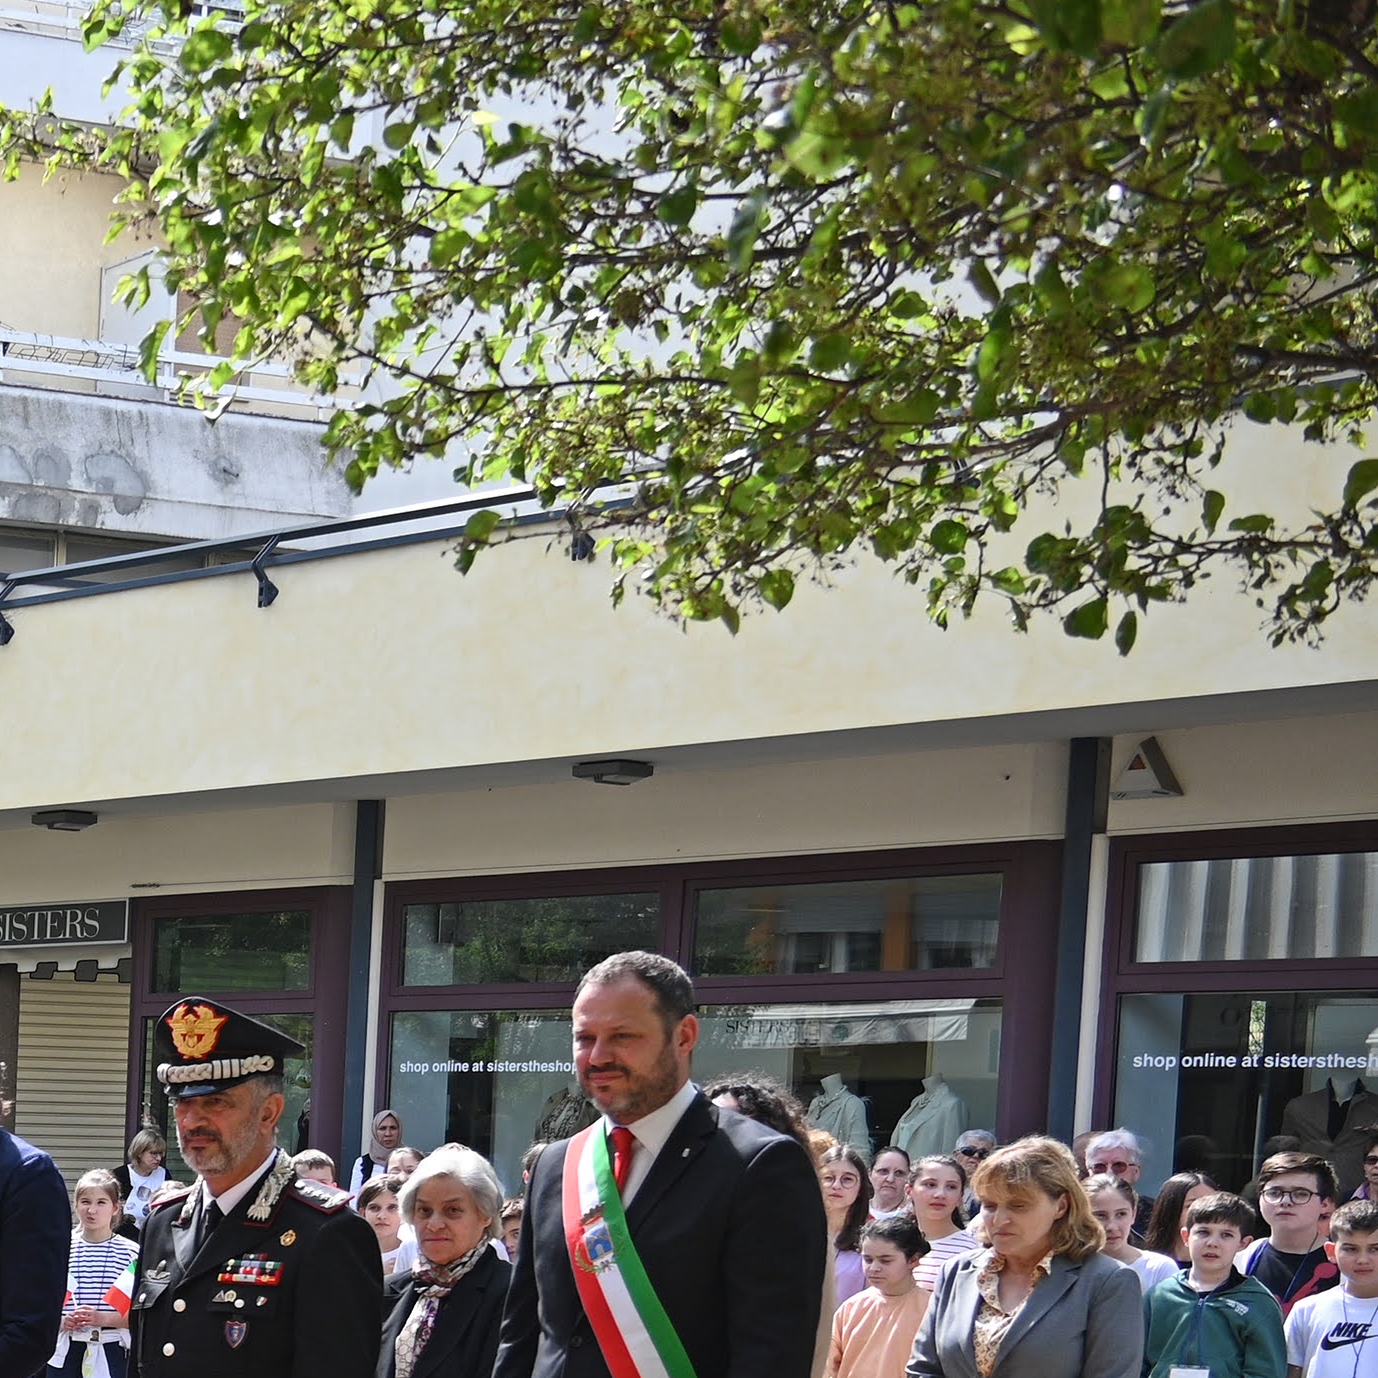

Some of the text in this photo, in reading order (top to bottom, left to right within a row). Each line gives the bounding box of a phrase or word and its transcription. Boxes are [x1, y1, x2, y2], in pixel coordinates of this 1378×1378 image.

[399, 1060, 429, 1075] shop
[432, 1059, 470, 1073] online
[471, 1060, 484, 1073] at
[1132, 1052, 1177, 1071] shop
[1181, 1052, 1237, 1068] online
[1240, 1053, 1258, 1068] at
[1329, 1321, 1373, 1338] NIKE
